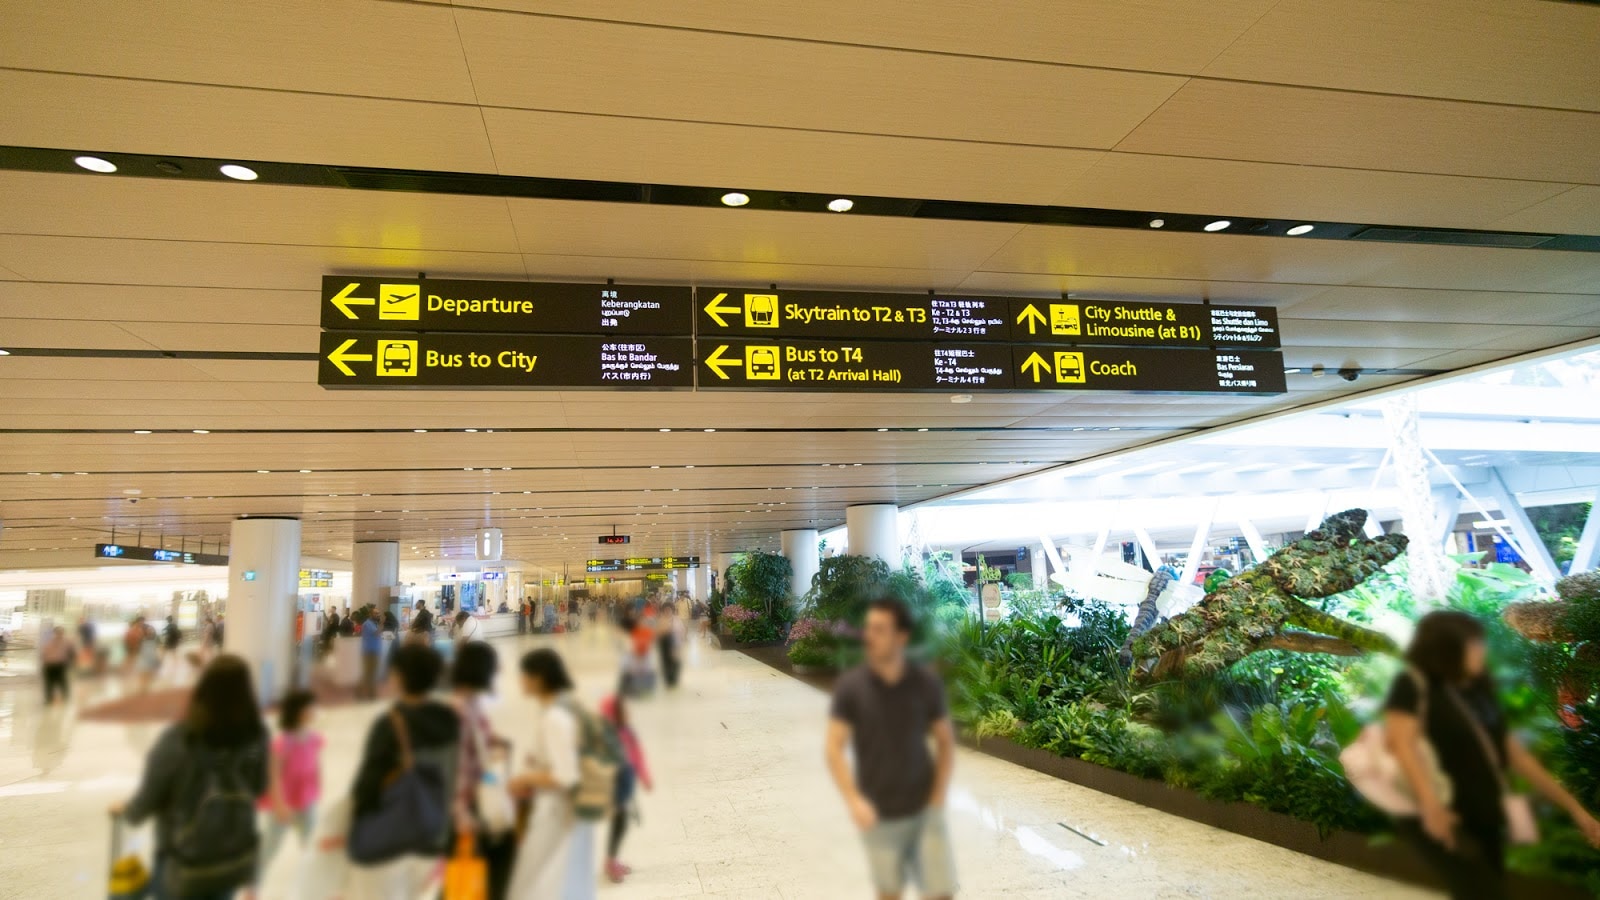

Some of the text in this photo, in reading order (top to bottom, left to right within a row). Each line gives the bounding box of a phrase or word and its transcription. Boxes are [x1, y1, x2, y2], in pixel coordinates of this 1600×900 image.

[428, 295, 533, 315] Departure
[602, 300, 660, 314] Keberangkatan
[785, 304, 926, 323] Skytrain to T2 & T3
[946, 309, 954, 317] T2
[961, 309, 971, 317] T3
[1085, 306, 1176, 321] City Shuttle &
[1087, 323, 1154, 337] Limousine
[1158, 325, 1176, 339] (at
[1180, 326, 1200, 340] B1)
[426, 350, 537, 372] Bus to City
[618, 353, 627, 361] ke
[629, 353, 658, 362] Bandar
[786, 346, 863, 362] Bus to T4
[788, 368, 901, 383] (at T2 Arrival Hall)
[1090, 361, 1136, 375] Coach
